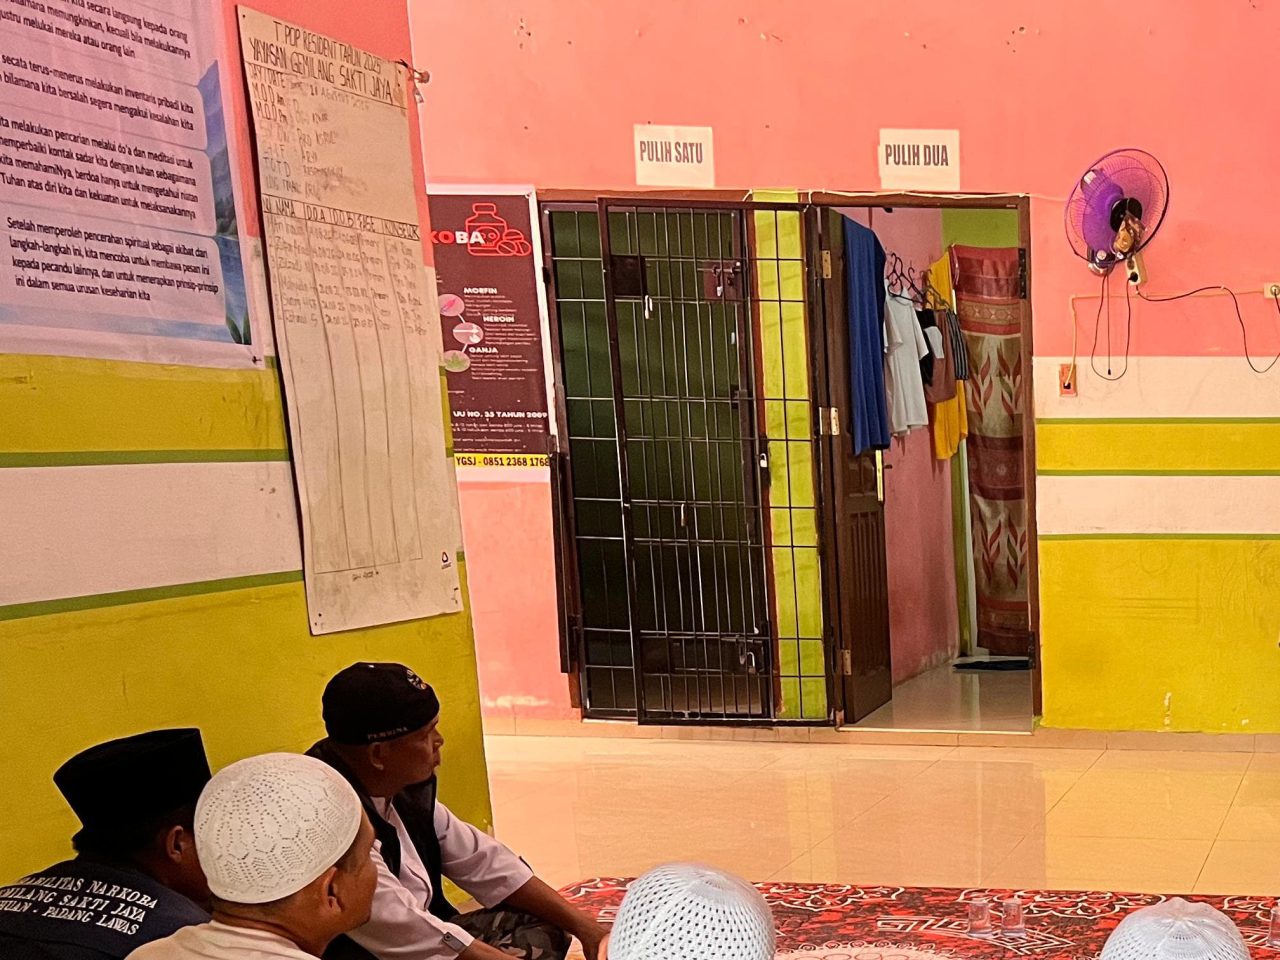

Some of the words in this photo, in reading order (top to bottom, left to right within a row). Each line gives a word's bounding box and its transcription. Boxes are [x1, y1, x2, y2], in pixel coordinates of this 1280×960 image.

[249, 36, 287, 70] YAYASAN
[290, 51, 335, 84] GEMILANG
[340, 64, 367, 94] SAKTI
[370, 75, 394, 106] JAYA
[41, 81, 57, 96] kita
[639, 140, 672, 163] PULIH
[674, 142, 703, 164] SATU
[885, 143, 920, 166] PULIH
[923, 144, 949, 166] DUA
[483, 315, 515, 323] HEROIN
[456, 457, 477, 466] YGSJ
[483, 457, 505, 467] 0851
[506, 457, 528, 467] 2368
[86, 880, 159, 909] NARKOBA
[59, 894, 110, 911] SAKTI
[111, 902, 147, 922] JAYA
[42, 907, 94, 923] PADANG
[96, 914, 140, 935] LAWAS
